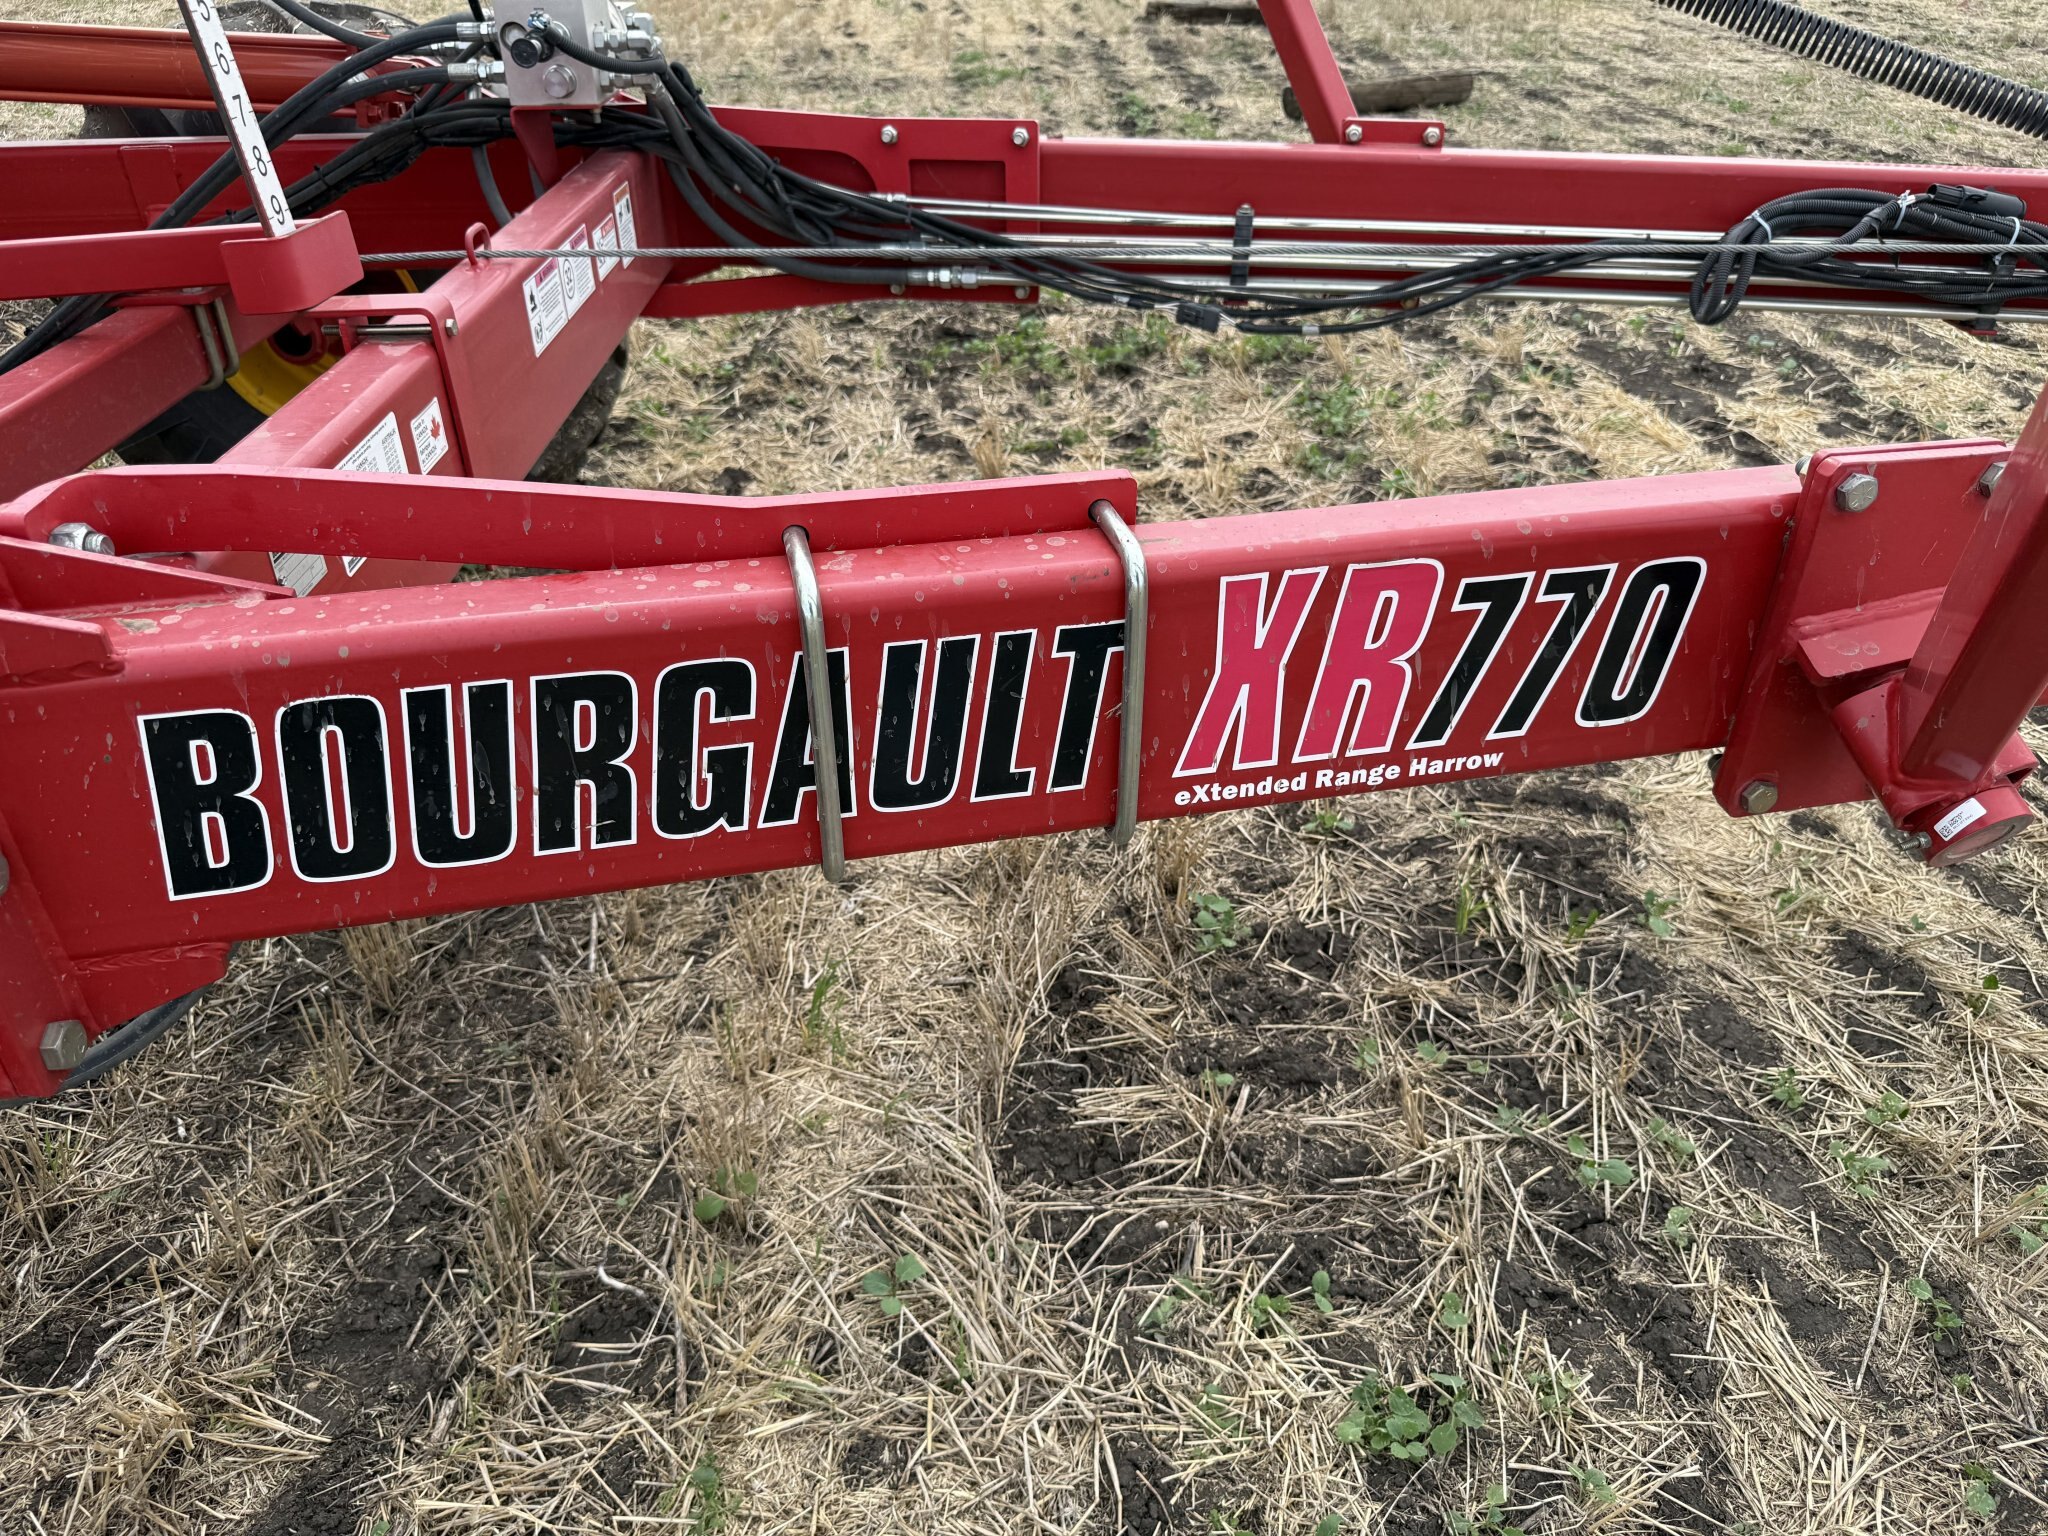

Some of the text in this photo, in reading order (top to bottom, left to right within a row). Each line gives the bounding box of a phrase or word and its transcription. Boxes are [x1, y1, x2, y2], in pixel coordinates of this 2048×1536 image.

[199, 0, 211, 22] 5
[214, 41, 231, 75] 6
[232, 94, 247, 127] 7
[252, 145, 268, 177] 8
[270, 194, 285, 225] 9
[137, 556, 1707, 901] BOURGAULT XR770
[1174, 752, 1505, 806] eXtended Range Harrow
